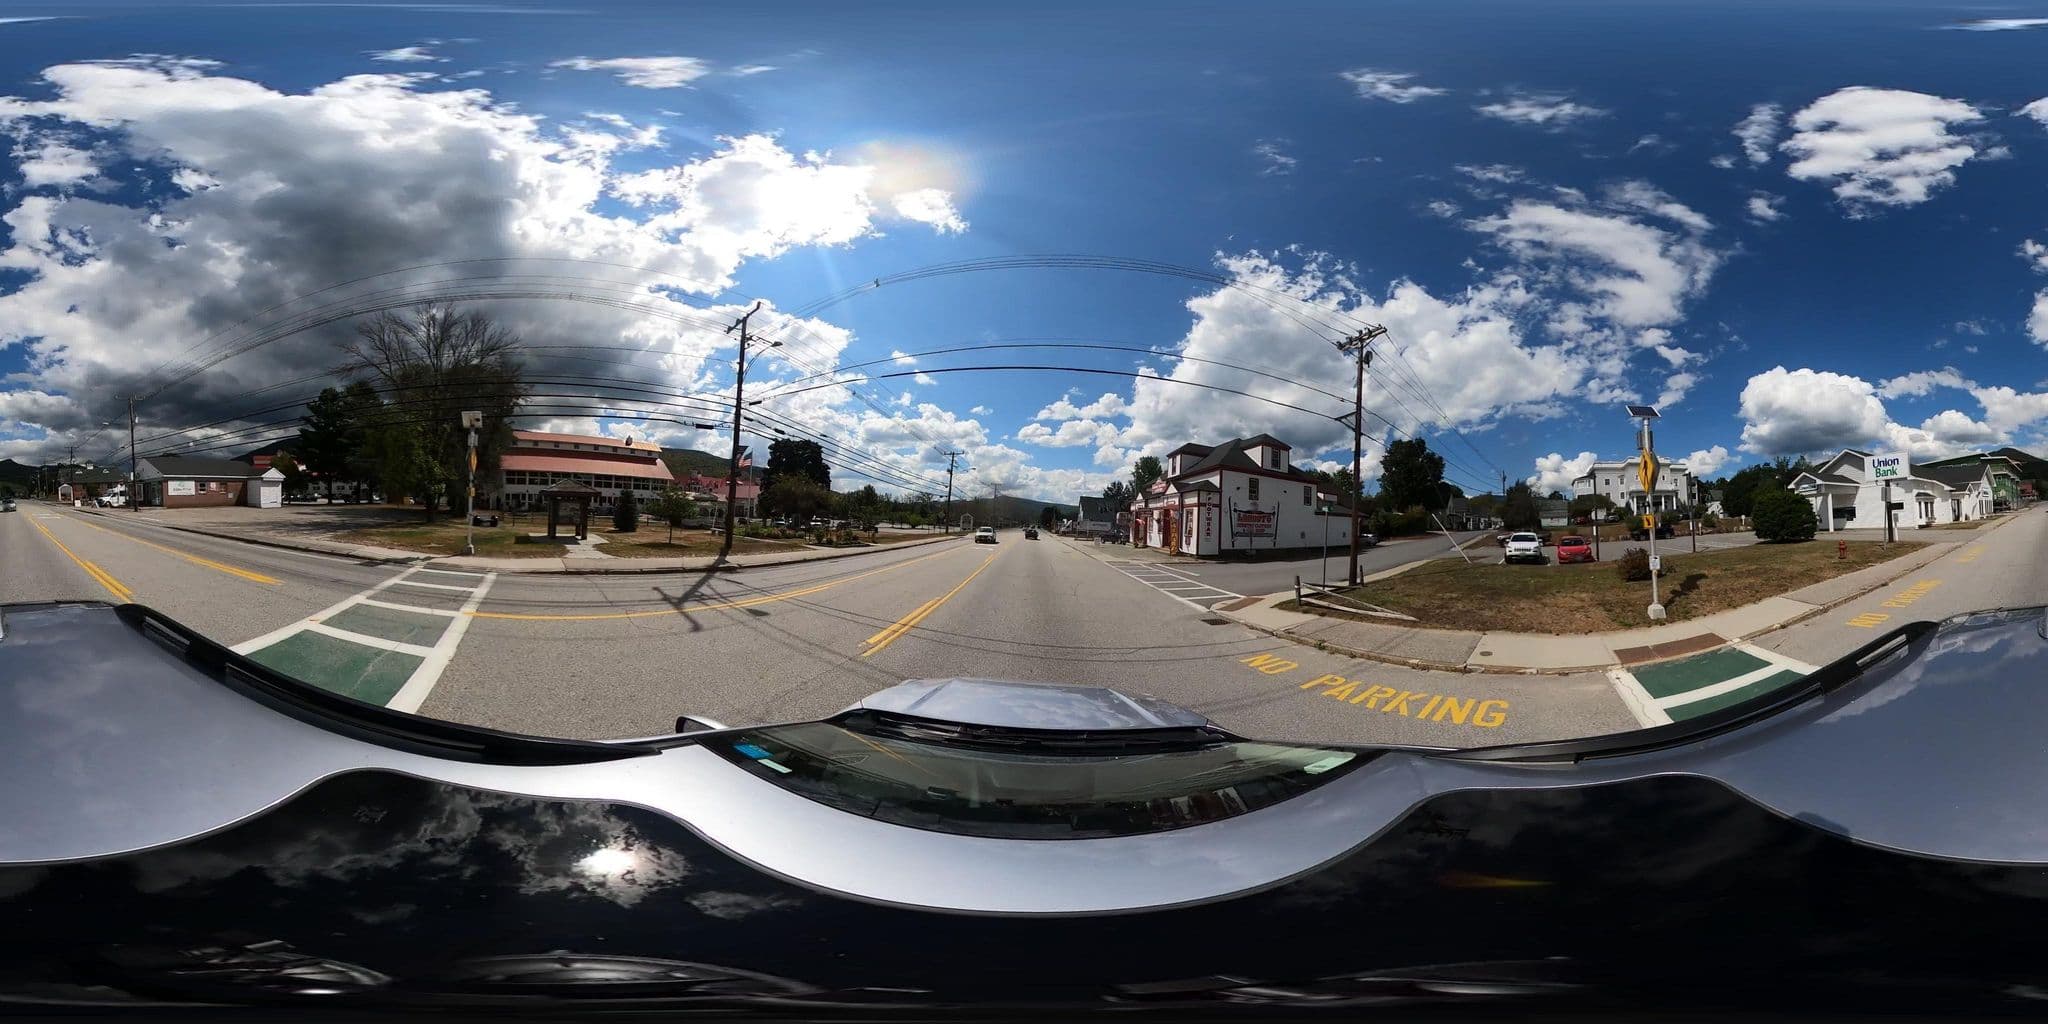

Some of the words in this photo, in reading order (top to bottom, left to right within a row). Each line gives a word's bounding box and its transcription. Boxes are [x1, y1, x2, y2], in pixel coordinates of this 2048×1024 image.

[1872, 458, 1899, 468] Union
[1875, 466, 1898, 478] Bank
[1239, 653, 1298, 675] NO
[1300, 674, 1509, 728] PARKING
